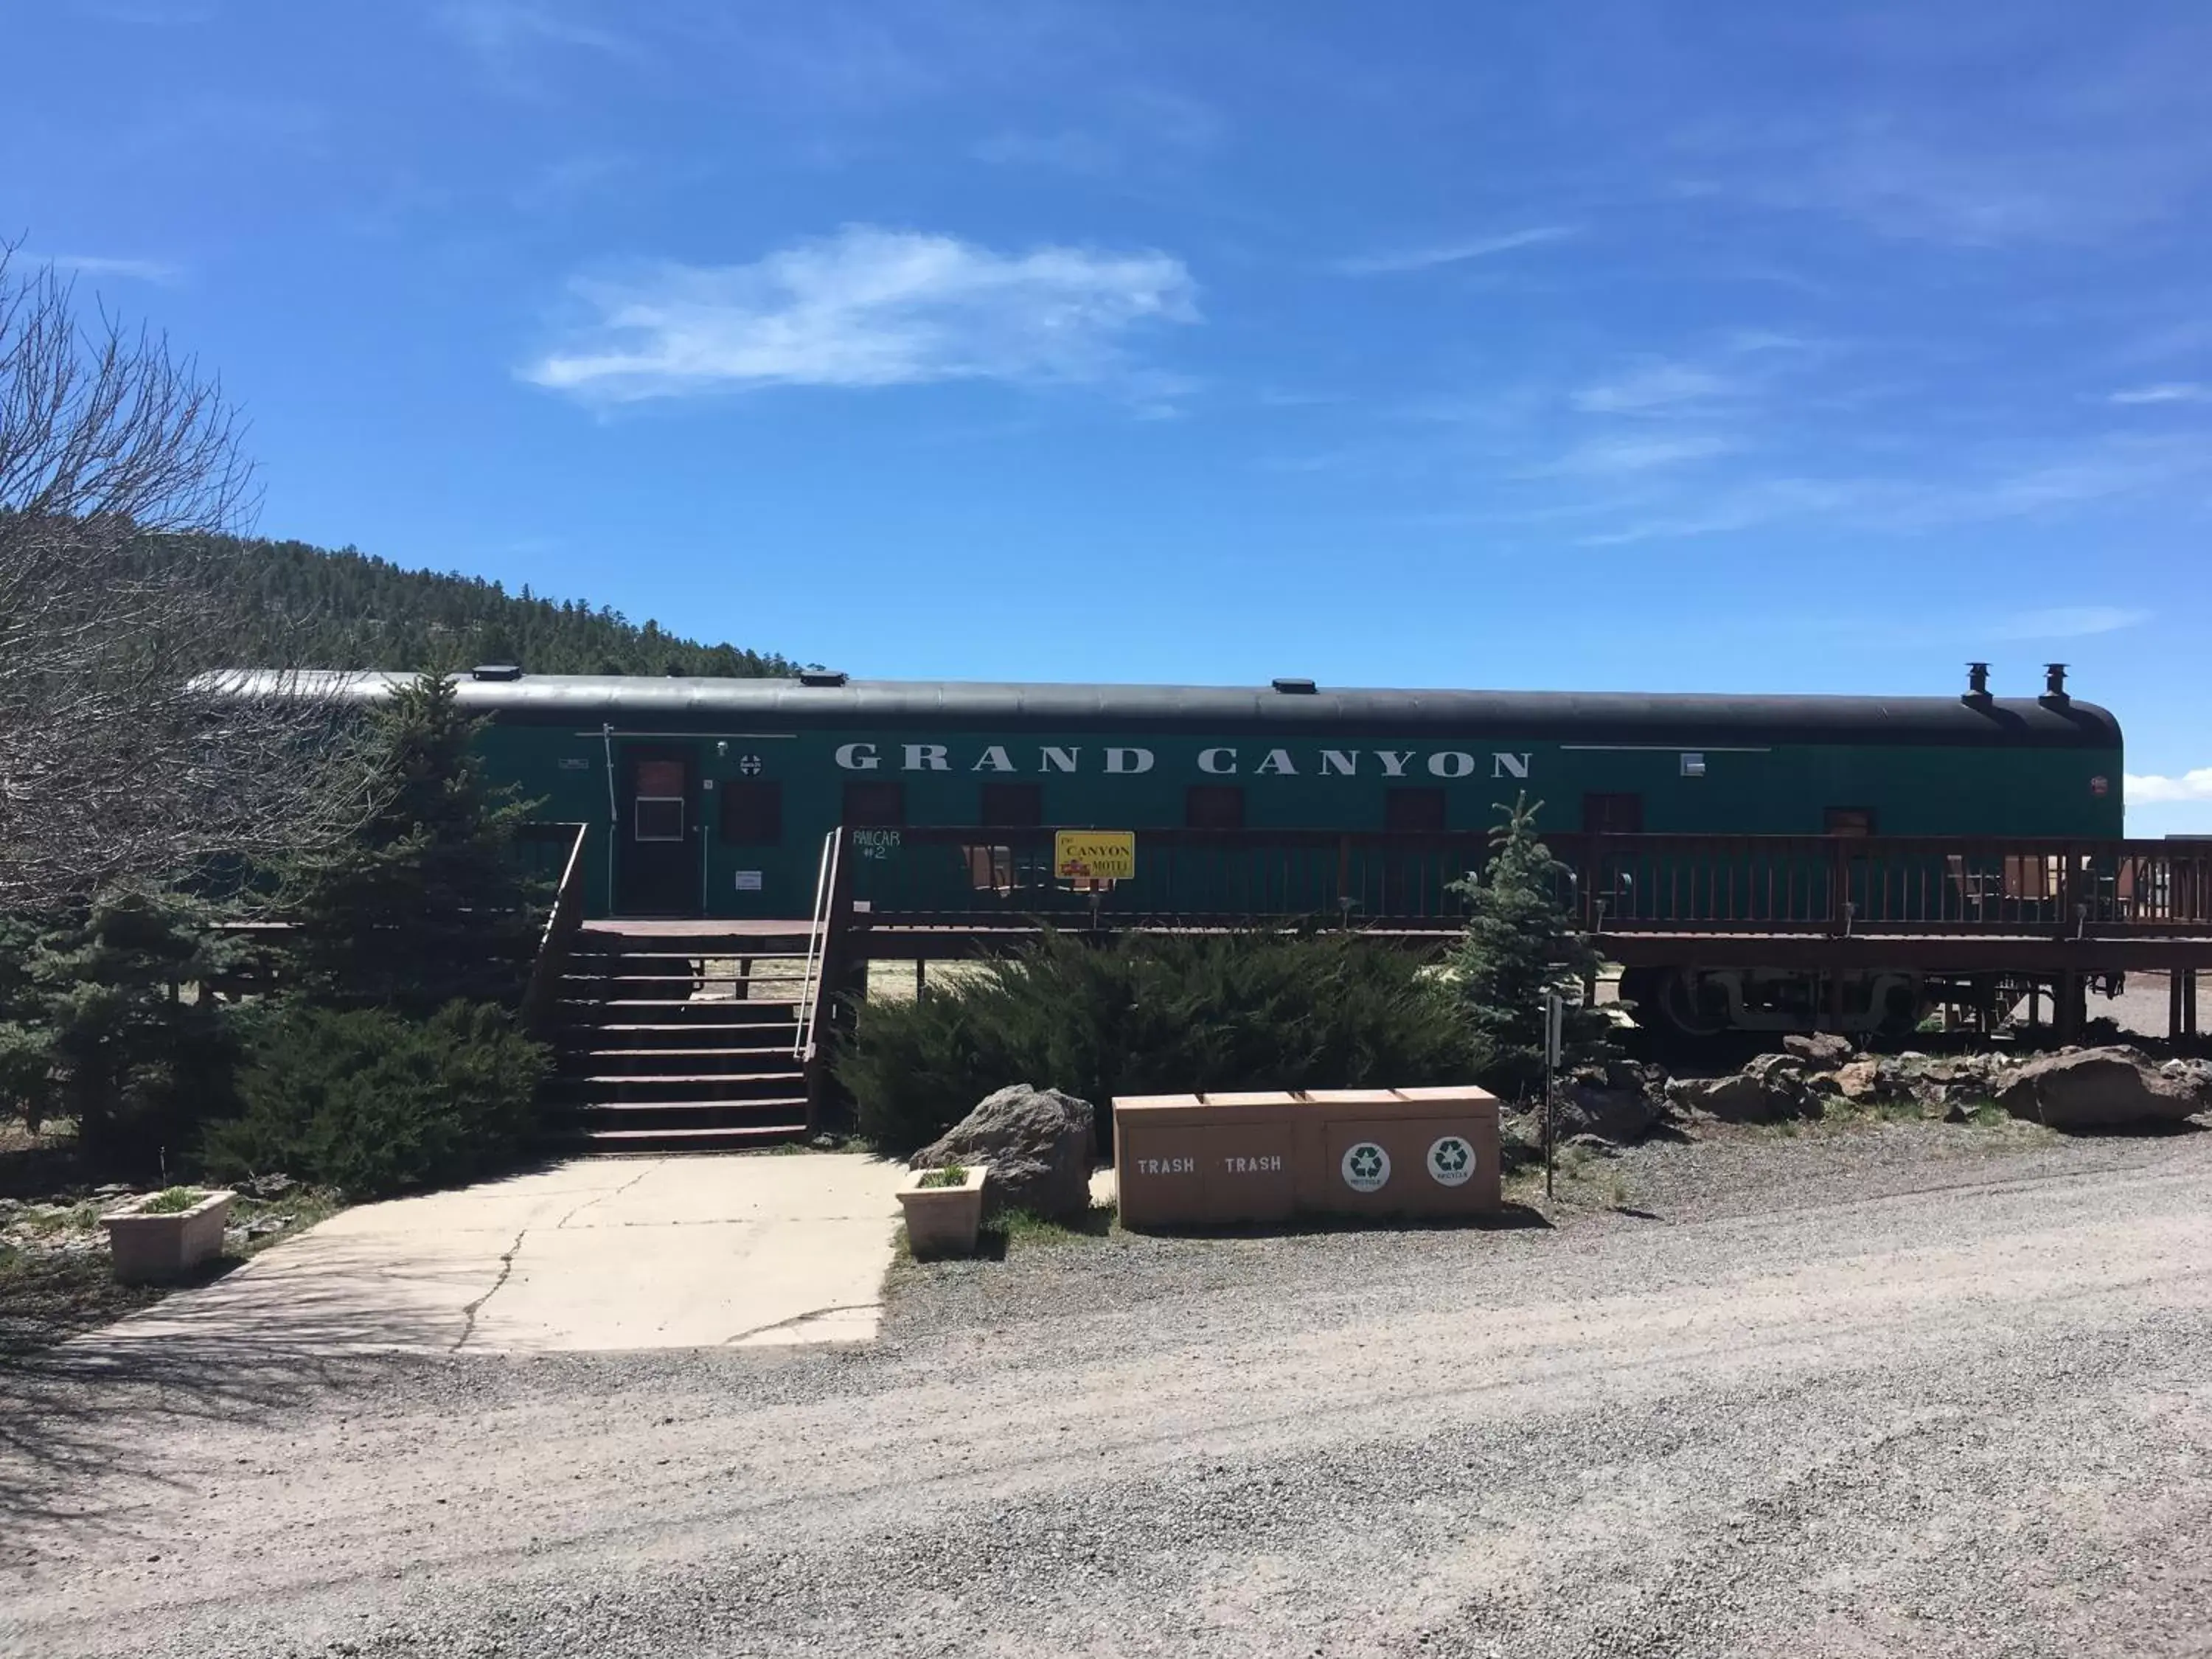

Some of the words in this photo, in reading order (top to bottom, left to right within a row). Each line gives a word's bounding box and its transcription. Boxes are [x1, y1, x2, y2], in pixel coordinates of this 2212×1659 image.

[835, 743, 1155, 773] GRAND
[1197, 748, 1534, 779] CANYON
[853, 830, 900, 847] RAILCAR
[864, 846, 887, 859] #2
[1067, 845, 1130, 856] CANYON
[1138, 1157, 1194, 1175] TRASH
[1225, 1156, 1281, 1173] TRASH
